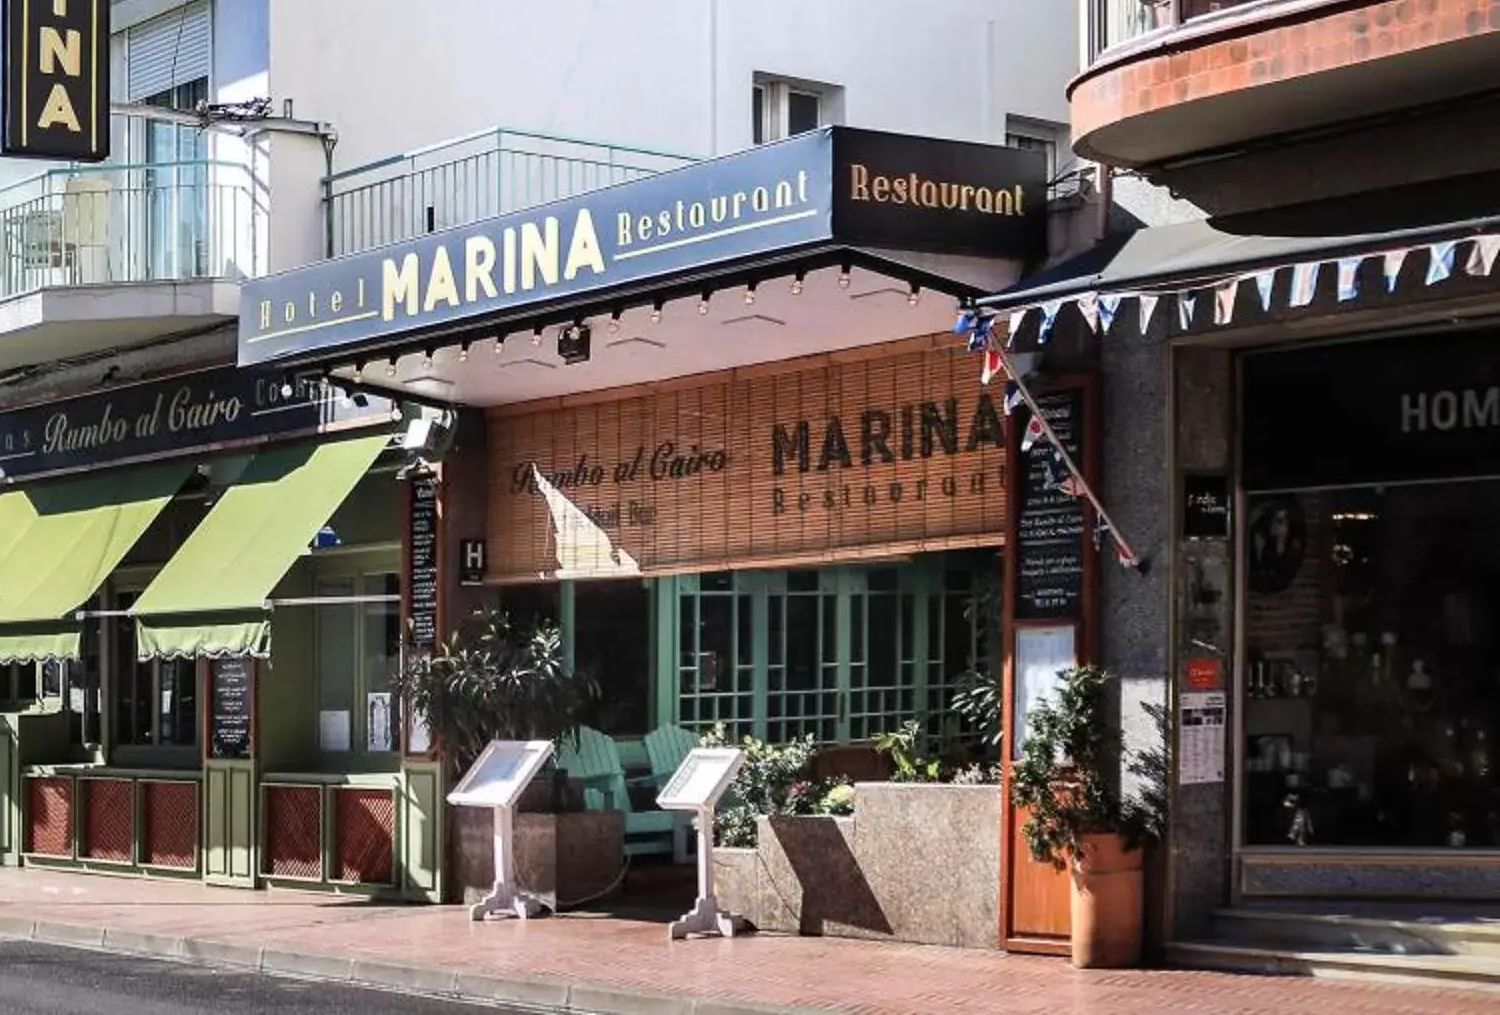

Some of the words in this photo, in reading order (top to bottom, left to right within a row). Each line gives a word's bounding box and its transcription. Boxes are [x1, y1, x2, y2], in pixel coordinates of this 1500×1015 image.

[850, 164, 1026, 217] Restaurant
[259, 278, 365, 330] Hotel
[382, 207, 605, 322] MARINA
[616, 170, 809, 246] Restaurant
[43, 402, 127, 454] Rumbo
[135, 393, 162, 437] al
[168, 386, 244, 432] Cairo
[772, 393, 1006, 476] MARINA
[1401, 385, 1500, 433] HOM
[613, 444, 645, 483] al
[649, 441, 727, 482] Cairo
[466, 542, 483, 569] H
